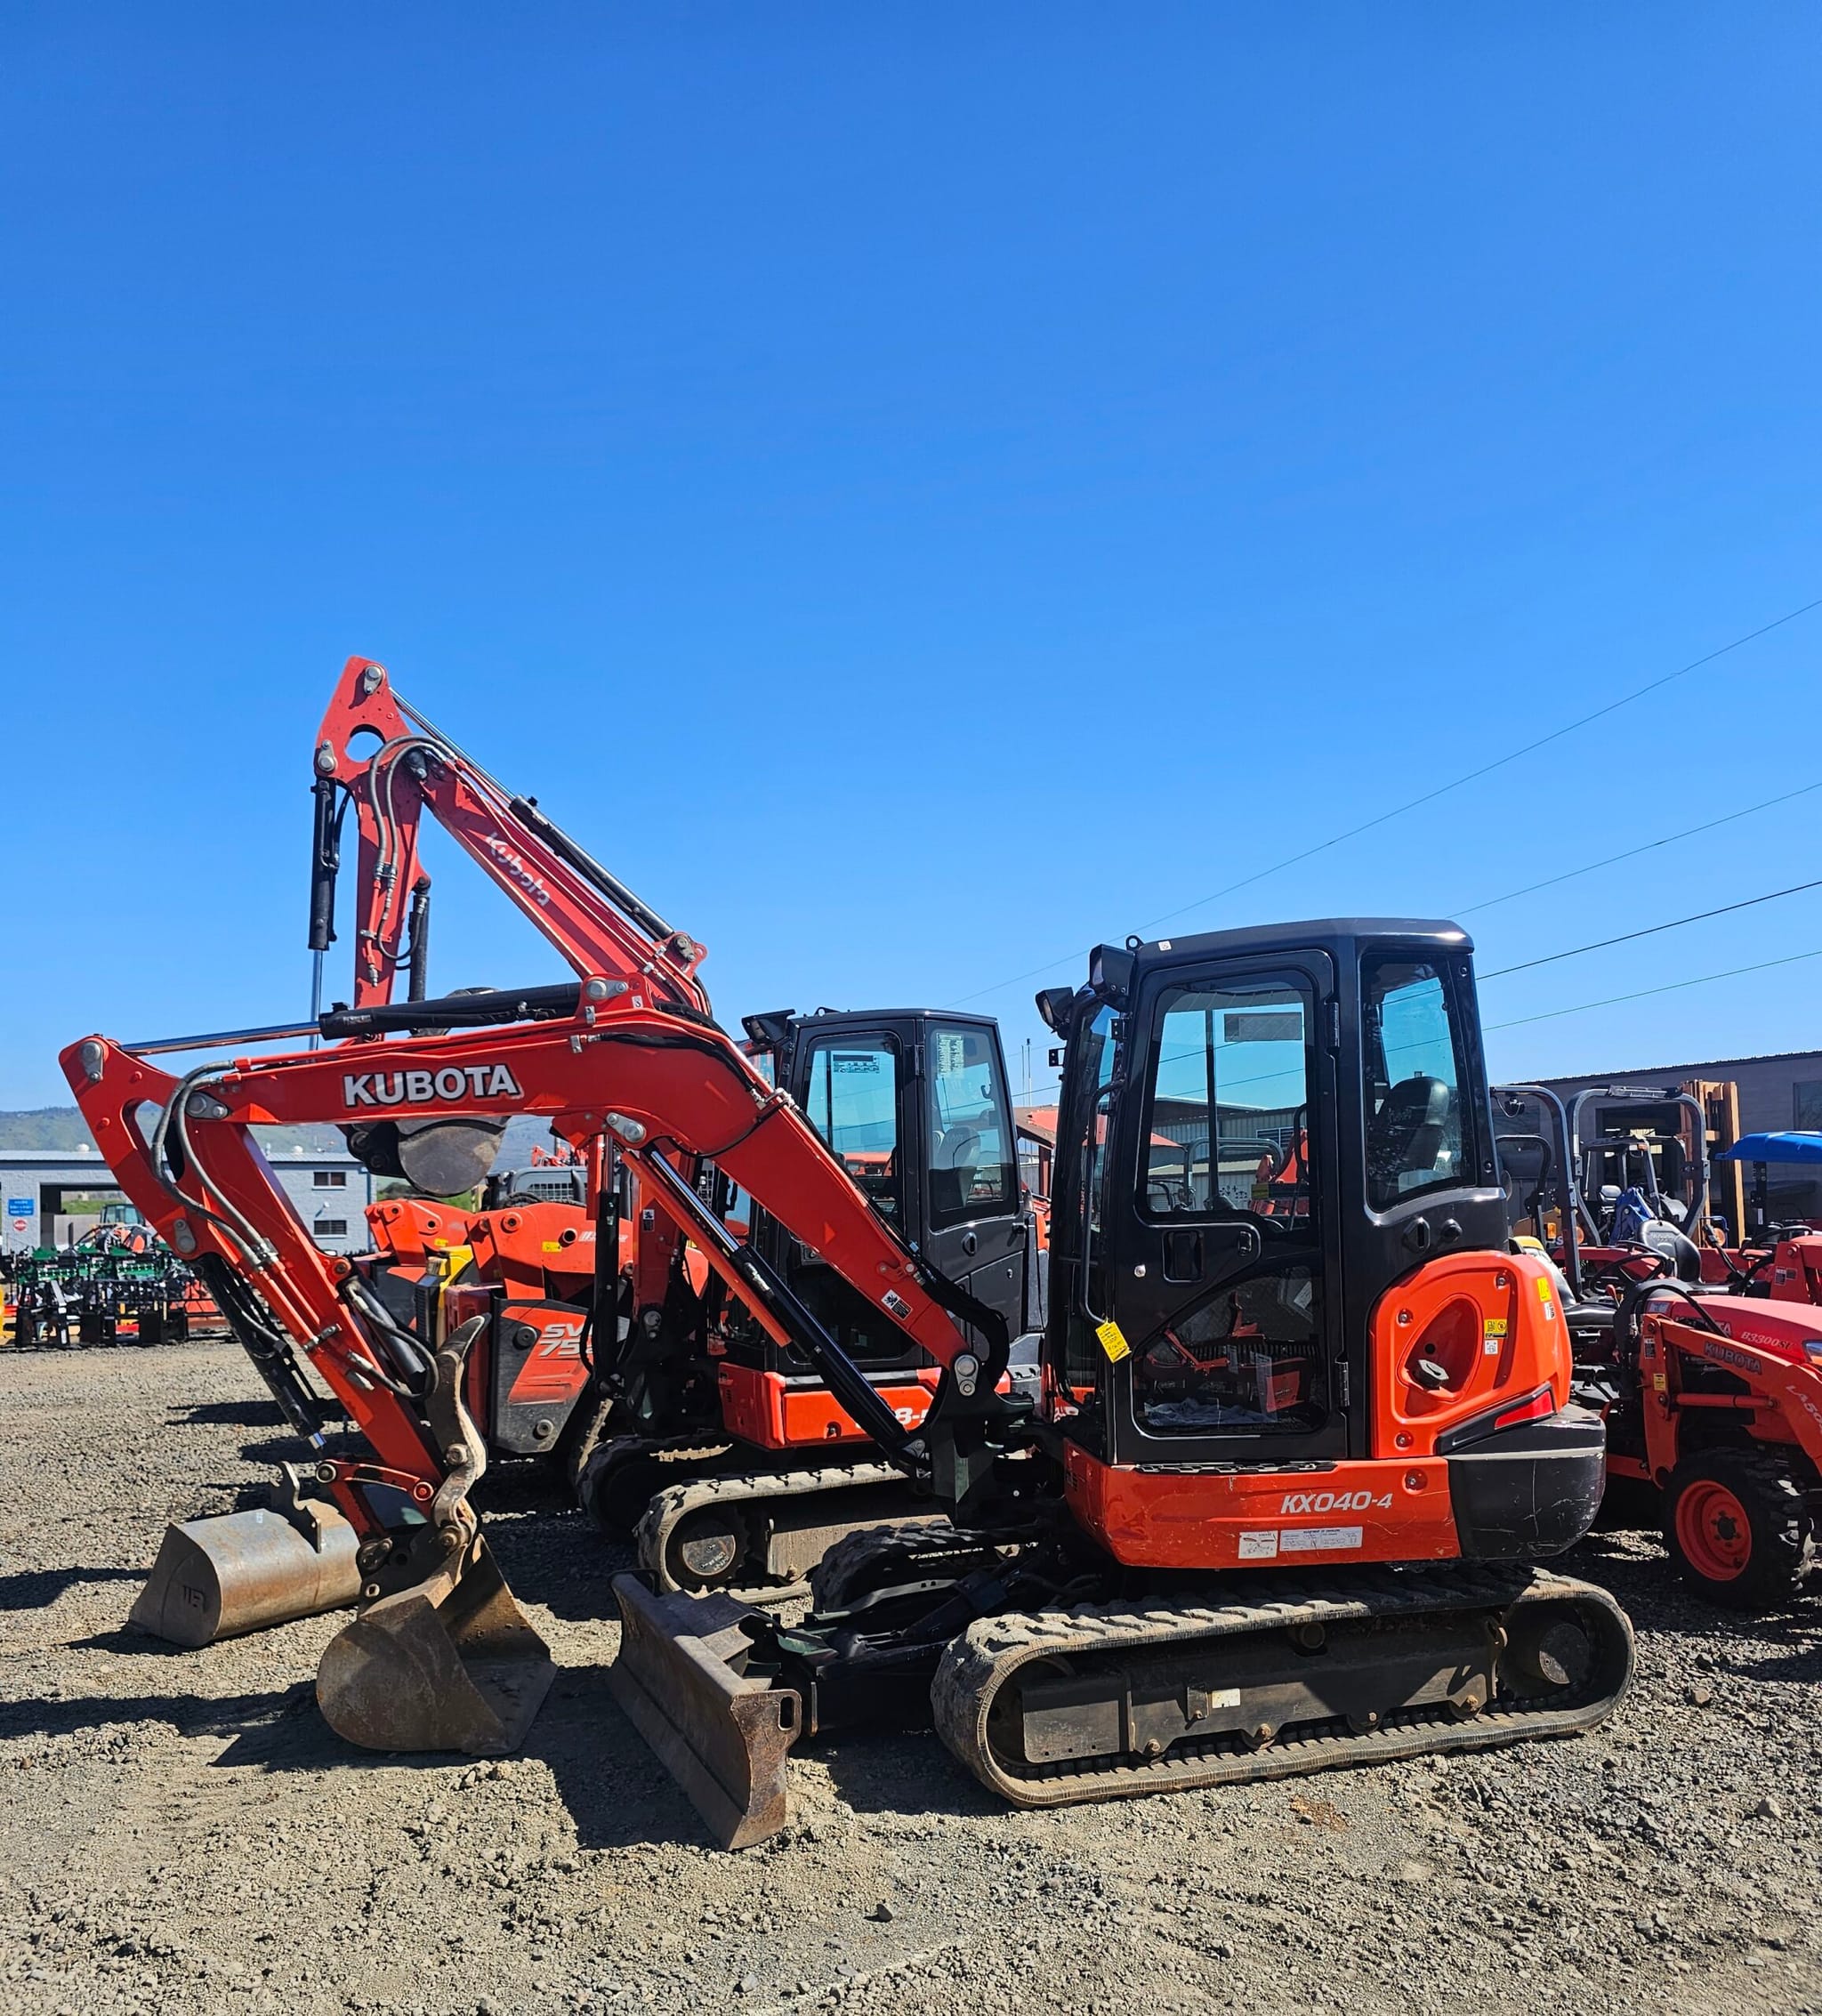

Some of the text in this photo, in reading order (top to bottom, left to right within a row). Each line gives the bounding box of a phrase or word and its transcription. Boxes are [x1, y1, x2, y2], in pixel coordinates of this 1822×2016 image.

[485, 832, 550, 907] Kubota
[343, 1065, 520, 1106] KUBOTA
[542, 1323, 593, 1339] SV
[1704, 1342, 1762, 1375] KUBOTA
[1786, 1384, 1822, 1435] LA50
[1280, 1490, 1394, 1514] KX040-4
